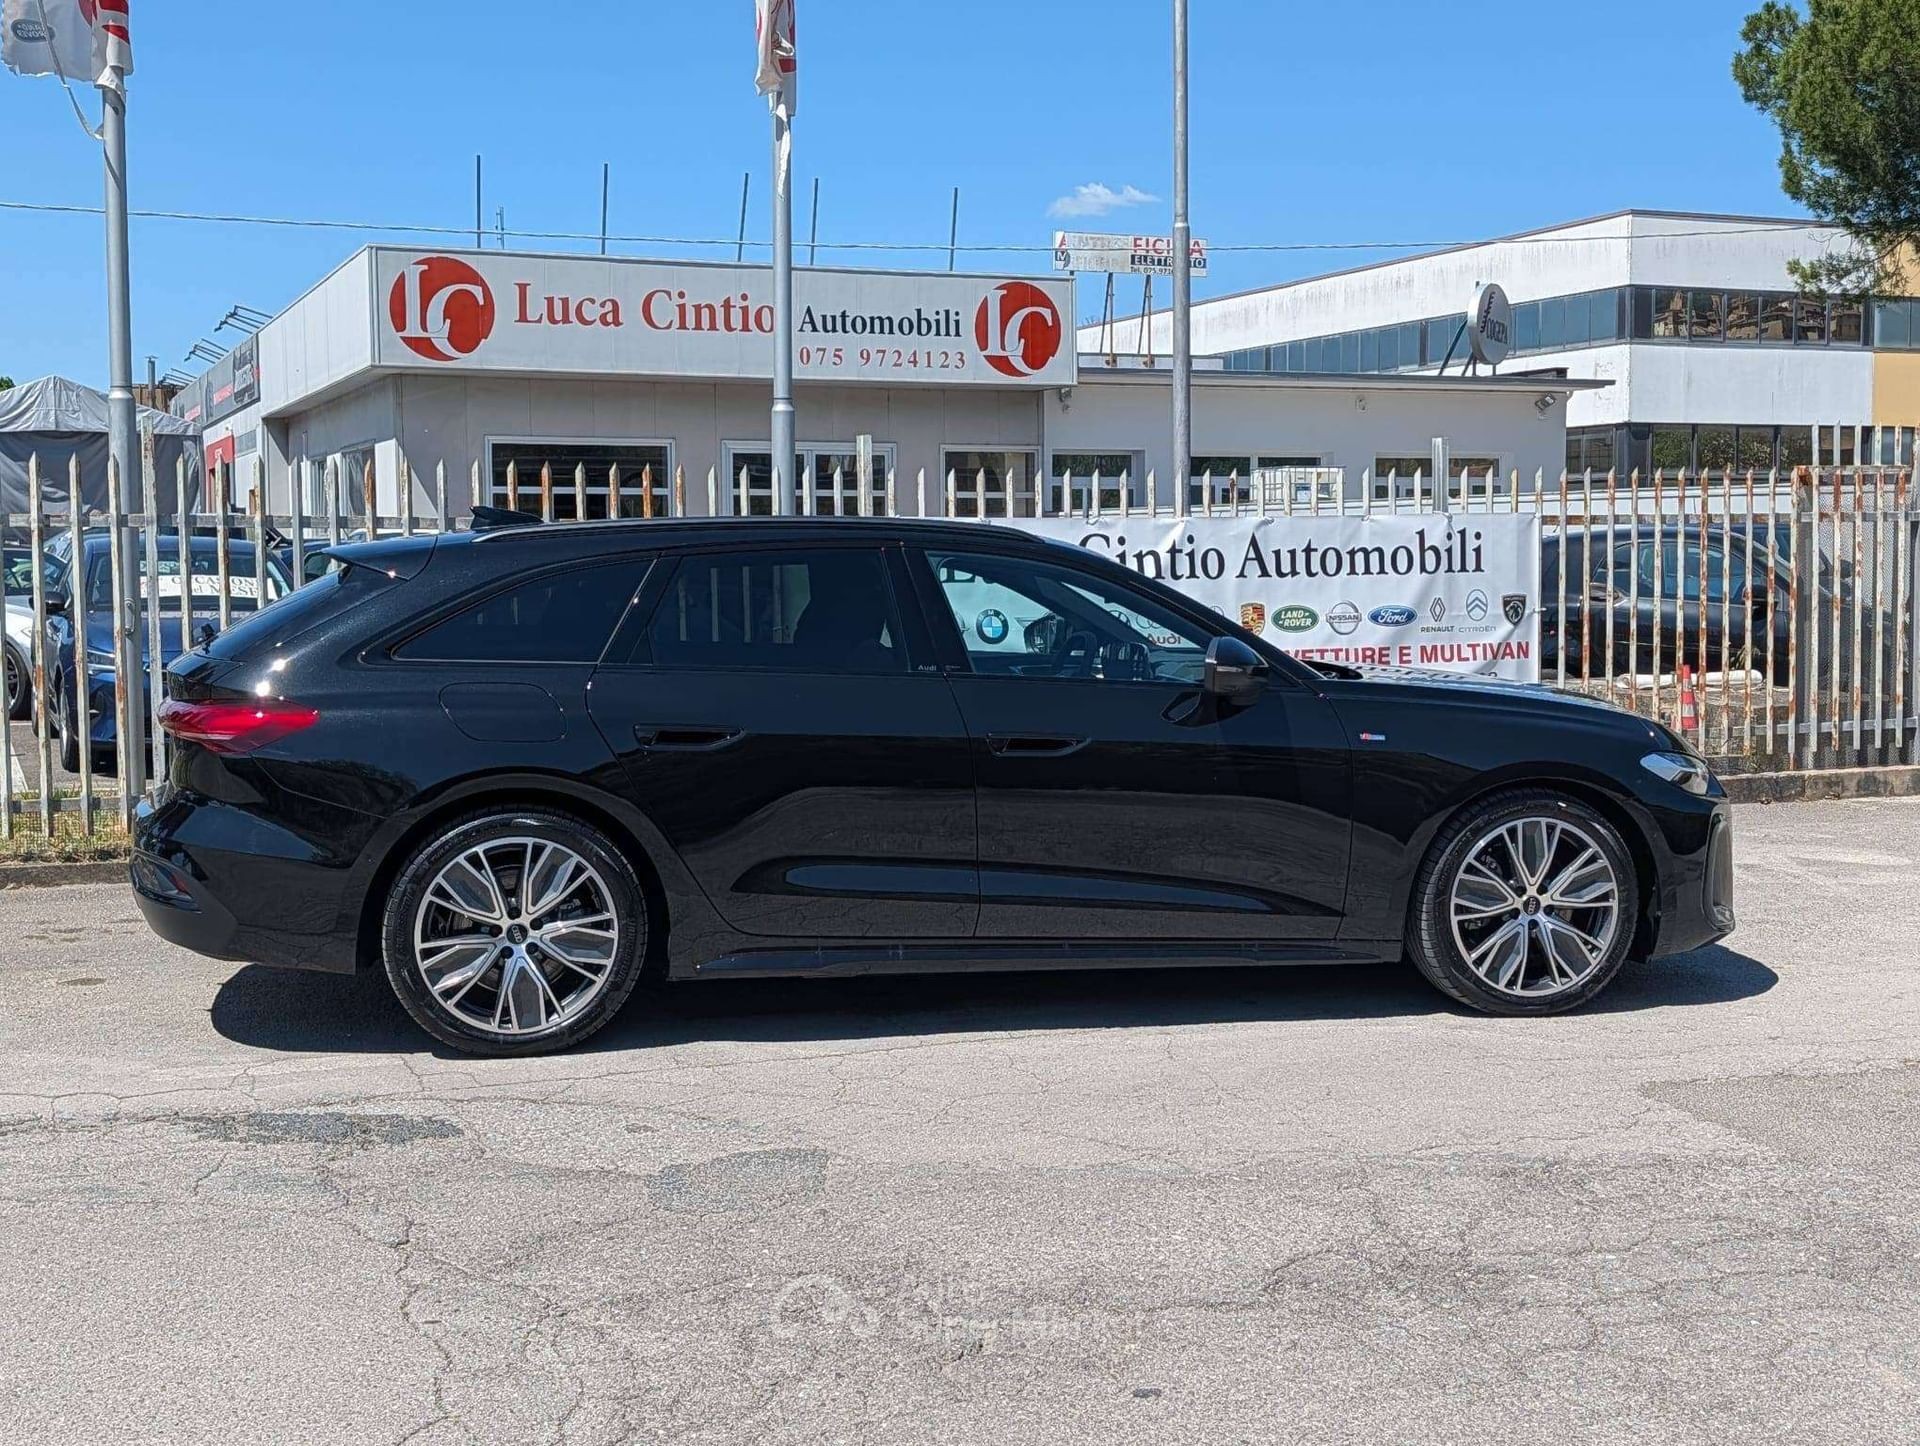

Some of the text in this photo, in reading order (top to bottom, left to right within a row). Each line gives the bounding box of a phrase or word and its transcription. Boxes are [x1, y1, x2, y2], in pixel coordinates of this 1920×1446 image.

[1133, 237, 1203, 257] FICIA
[1135, 255, 1204, 268] ELETTRTO
[513, 282, 775, 334] Luca Cintio
[797, 304, 963, 338] Automobili
[799, 346, 966, 369] 075 9724123
[1235, 527, 1485, 579] Automobili
[1377, 609, 1409, 623] Ford
[1420, 625, 1455, 633] RENAULT
[1398, 645, 1412, 665] E
[1419, 640, 1530, 664] MULTIVAN
